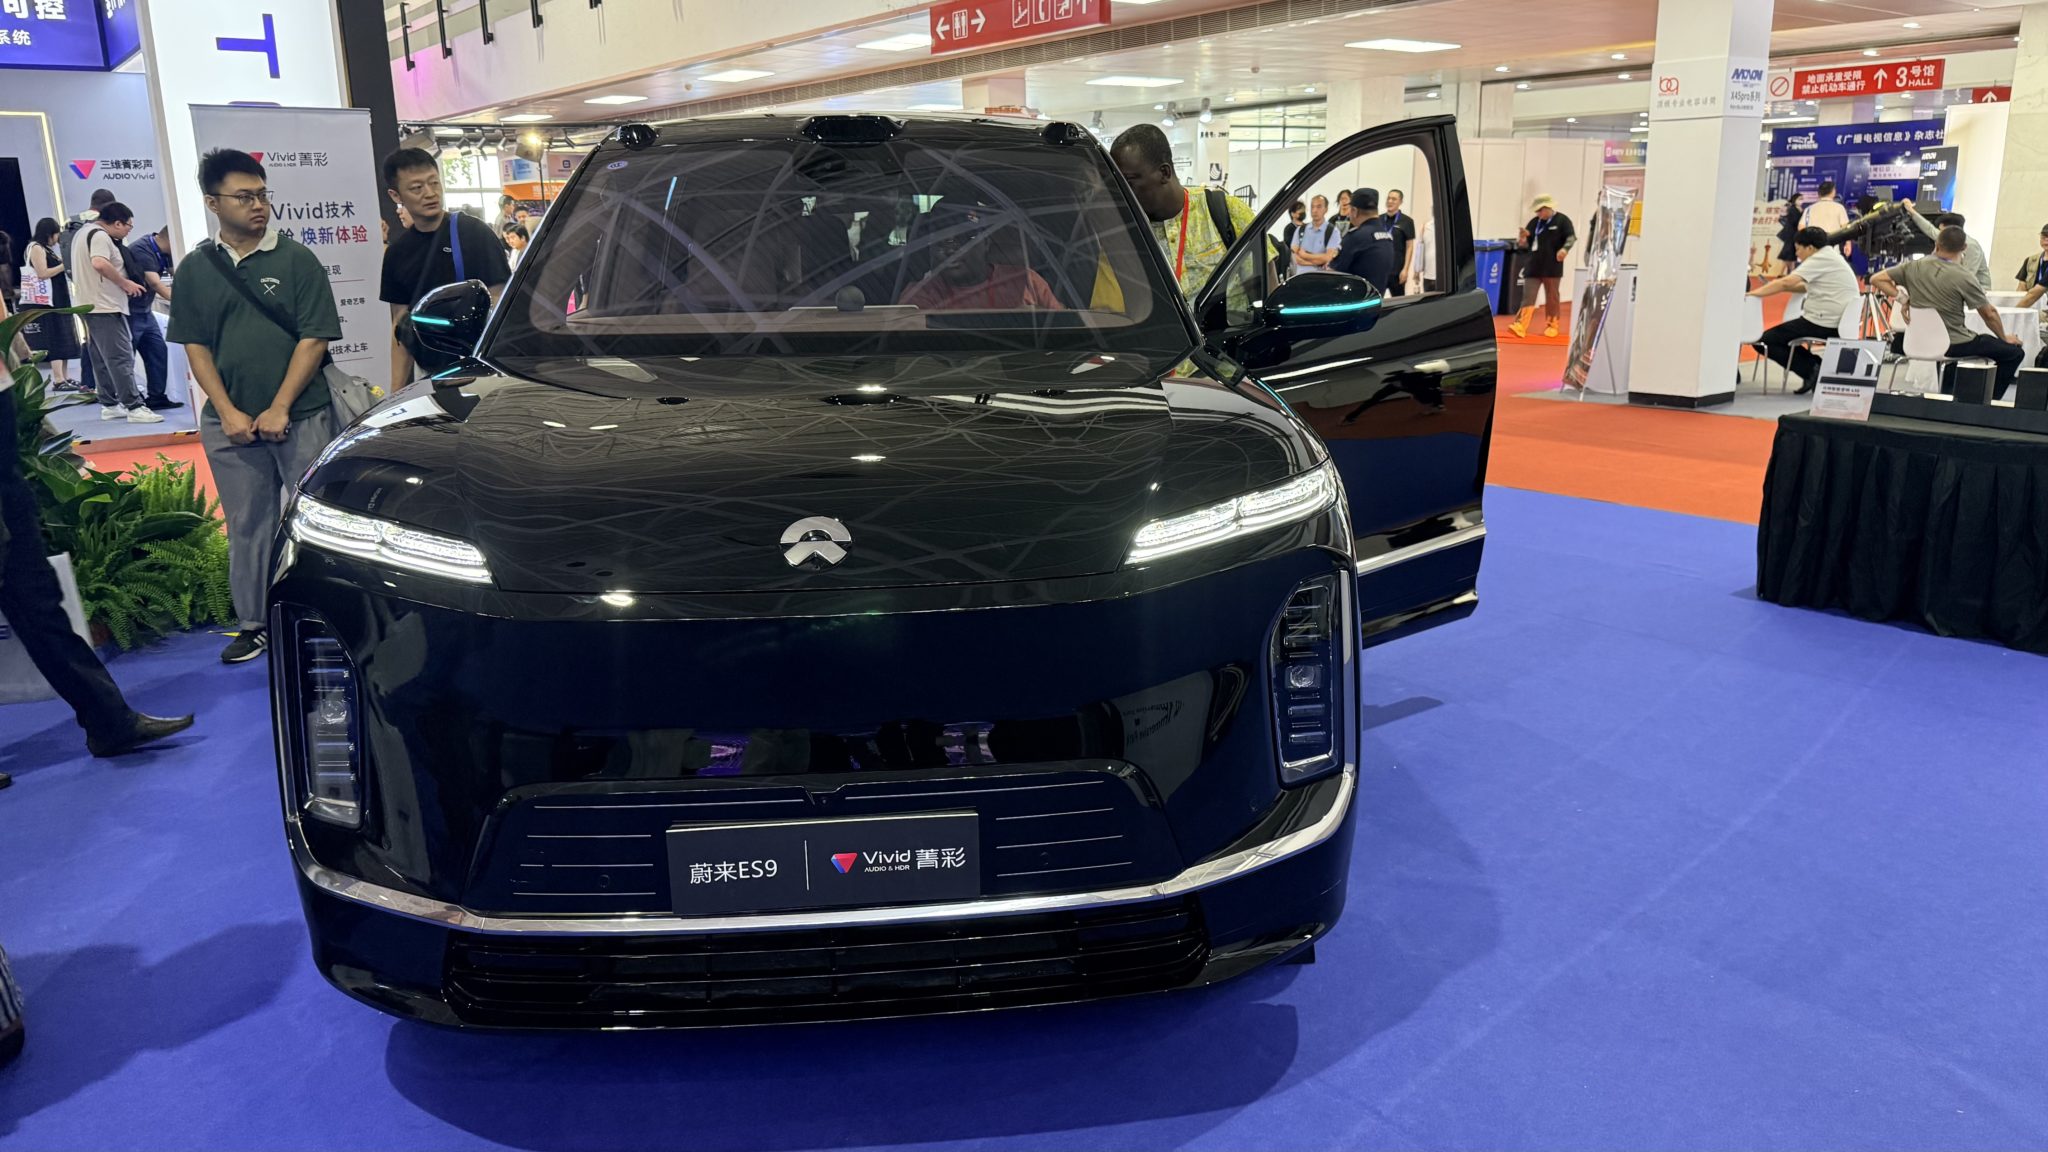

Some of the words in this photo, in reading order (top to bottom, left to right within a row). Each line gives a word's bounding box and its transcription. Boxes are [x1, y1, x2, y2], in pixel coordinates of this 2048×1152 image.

[1807, 70, 1862, 83] 地面承重受限
[1895, 67, 1908, 88] 3
[1910, 65, 1935, 77] 号馆
[1908, 78, 1934, 87] HALL
[1802, 80, 1866, 94] 禁止机动车通行
[100, 159, 153, 170] 三维菁彩声
[267, 152, 296, 162] Vivid
[298, 152, 328, 167] 菁彩
[301, 225, 368, 245] 焕新体验
[862, 850, 911, 865] Vivid
[915, 847, 966, 870] 菁彩
[689, 859, 778, 884] 蔚来ES9
[864, 865, 887, 873] AUDIO
